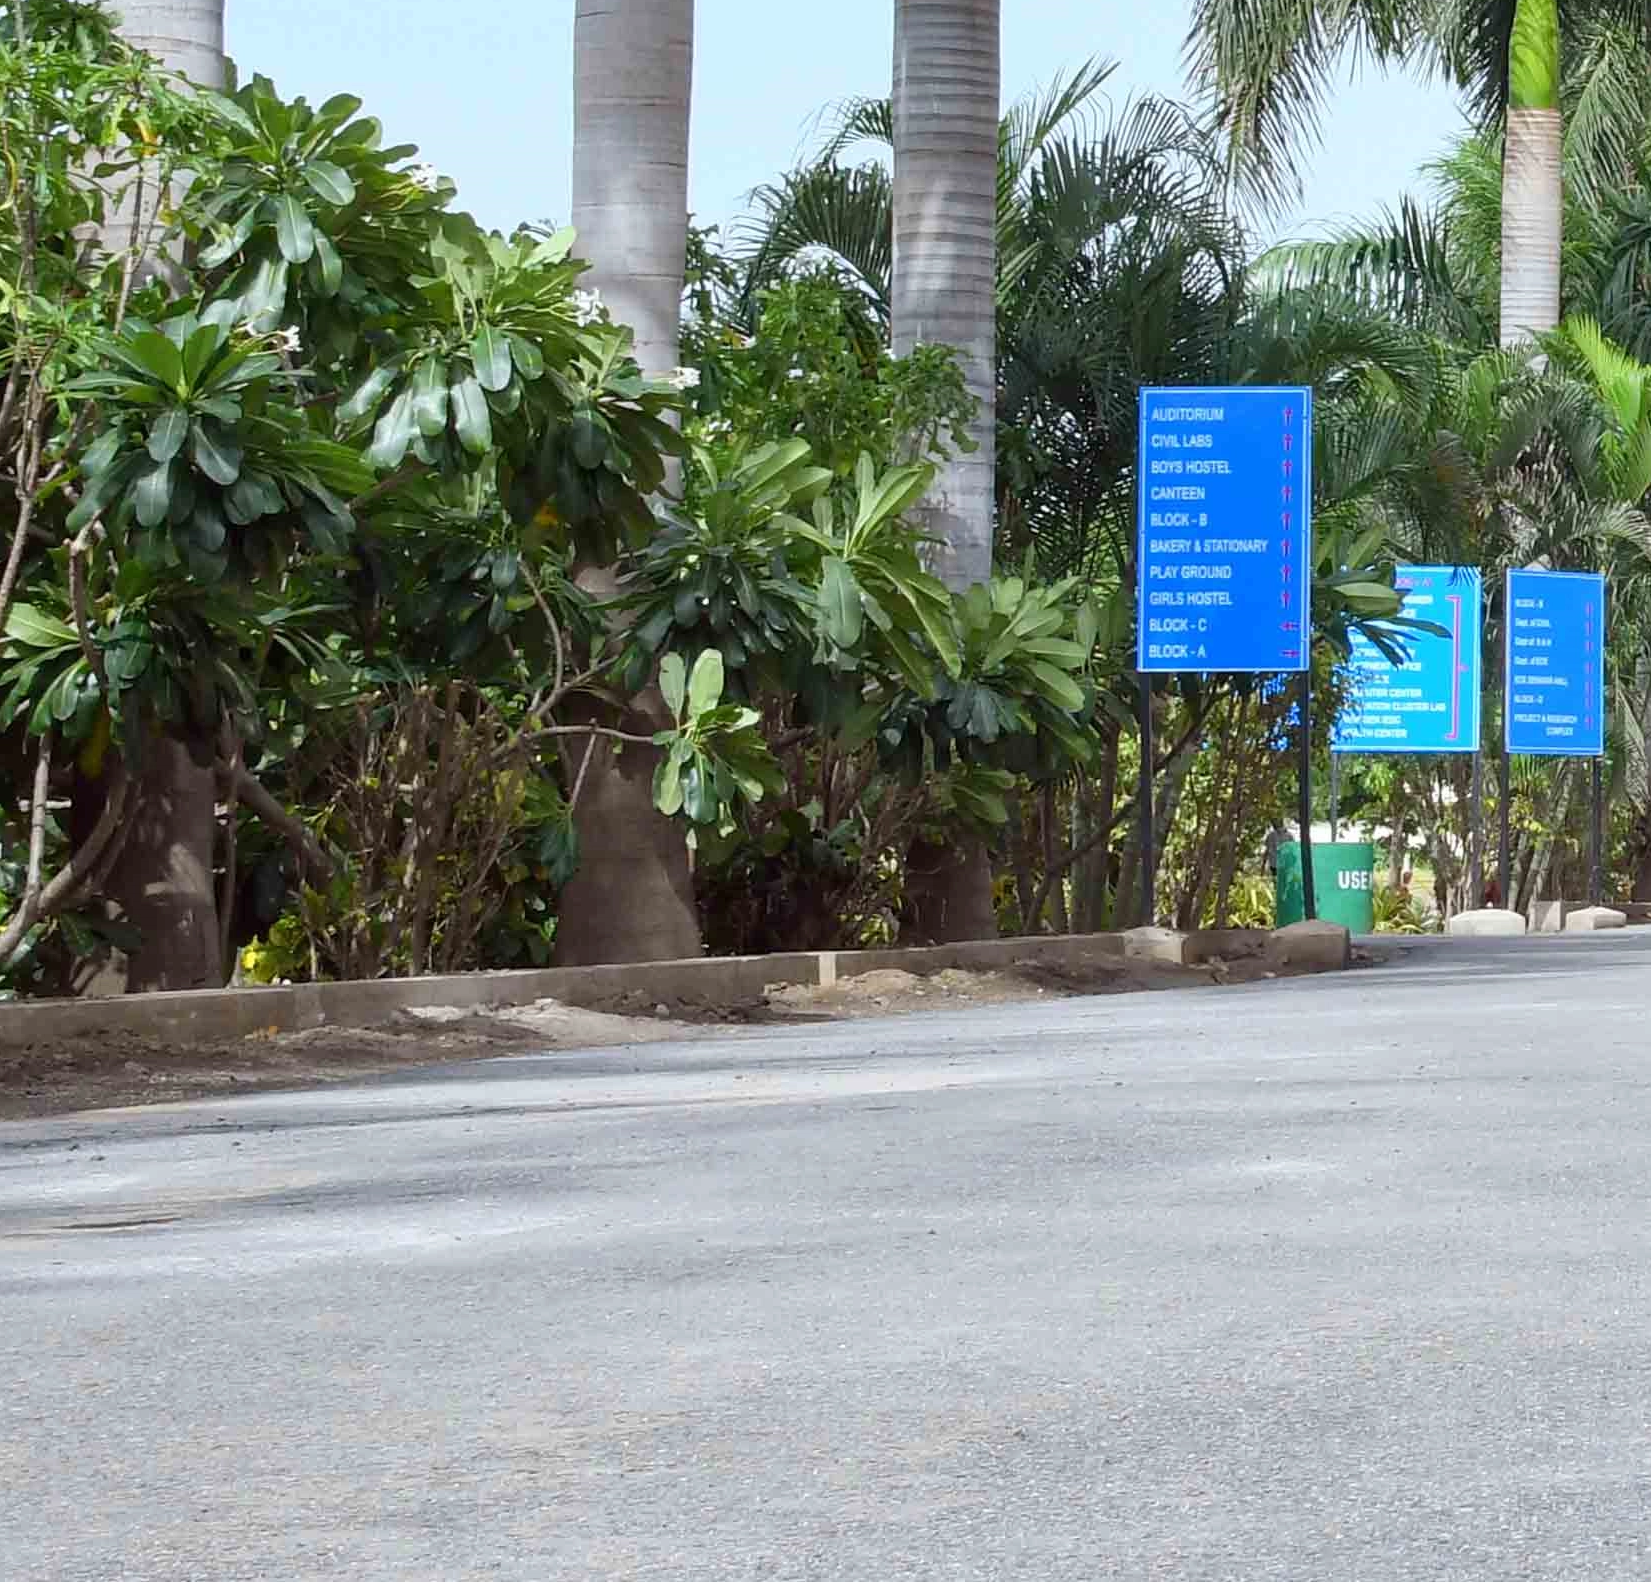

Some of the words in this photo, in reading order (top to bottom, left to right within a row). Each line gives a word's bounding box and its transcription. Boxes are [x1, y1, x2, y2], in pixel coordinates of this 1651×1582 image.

[1152, 407, 1224, 421] AUDITORIUM
[1152, 434, 1181, 448] CIVIL
[1183, 434, 1213, 448] LABS
[1151, 460, 1183, 474] BOYS
[1186, 460, 1230, 474] HOSTEL
[1151, 486, 1206, 500] CANTEEN
[1151, 513, 1189, 526] BLOCK
[1200, 513, 1207, 526] B
[1150, 539, 1191, 553] BAKERY
[1194, 539, 1201, 553] &
[1204, 539, 1267, 553] STATIONARY
[1150, 565, 1178, 579] PLAY
[1181, 565, 1232, 579] GROUND
[1150, 592, 1184, 606] GIRLS
[1187, 592, 1232, 606] HOSTEL
[1149, 618, 1188, 632] BLOCK
[1198, 618, 1206, 632] C
[1149, 645, 1188, 658] BLOCK
[1198, 645, 1206, 658] A
